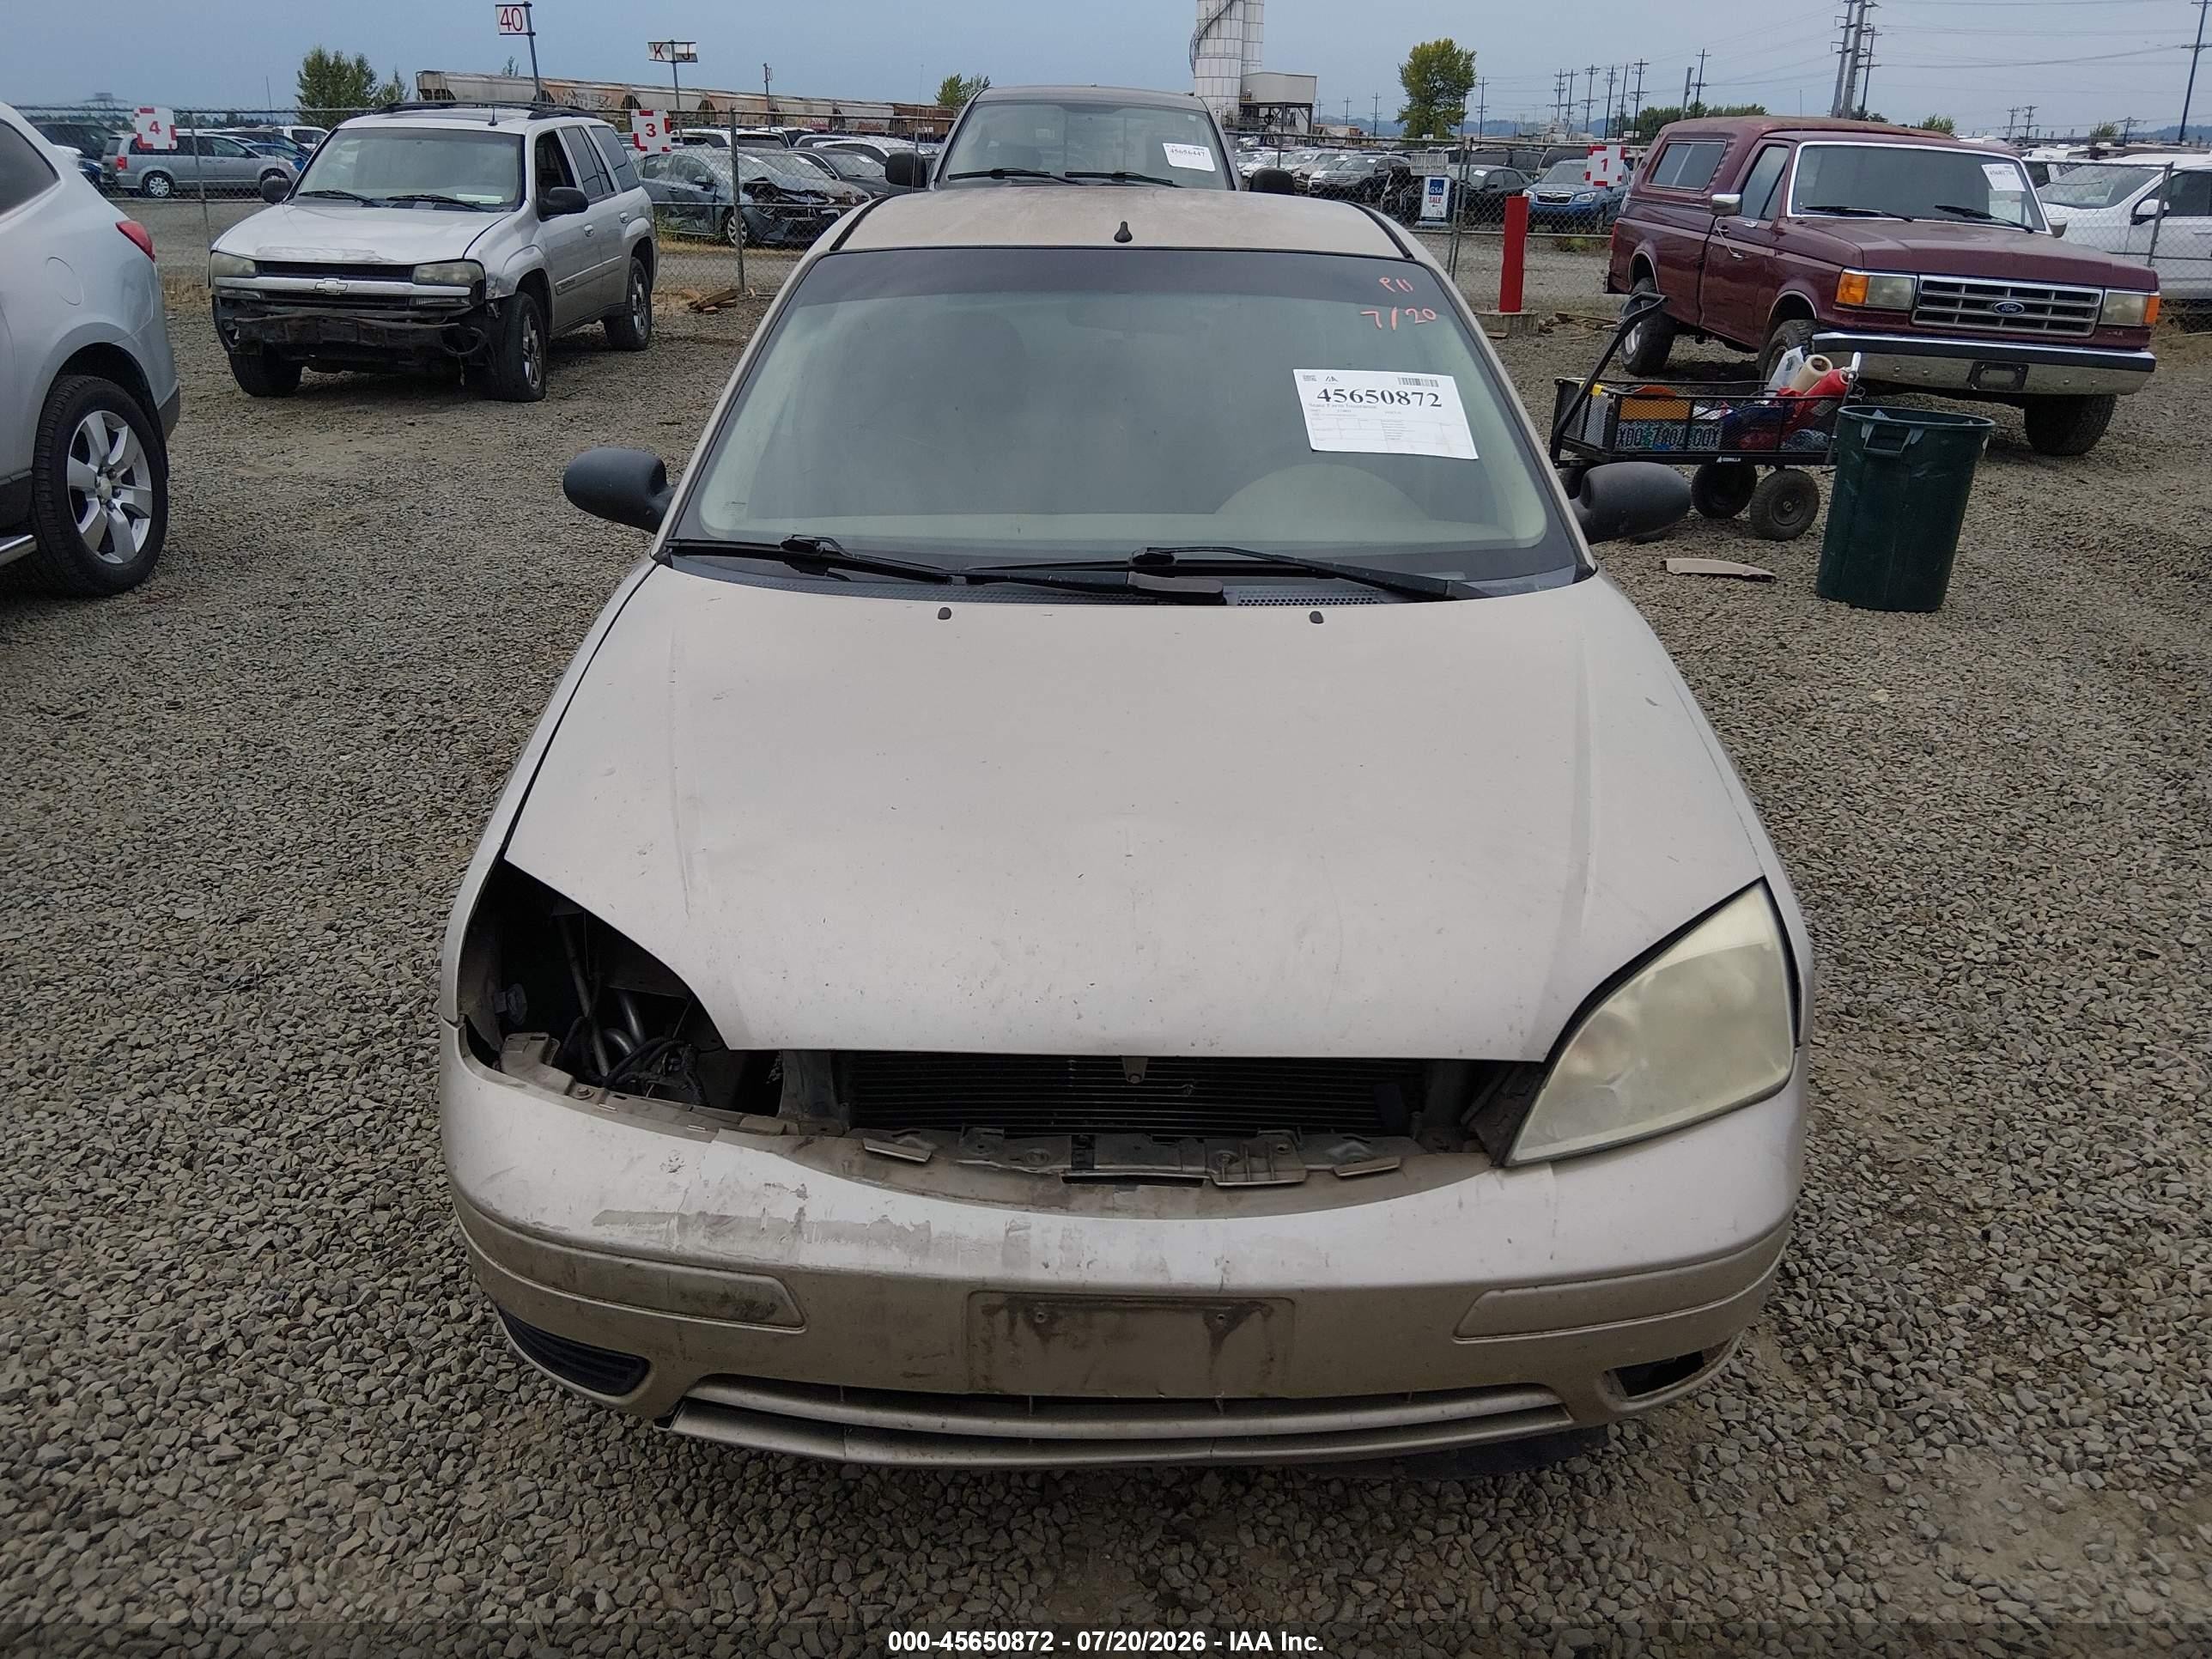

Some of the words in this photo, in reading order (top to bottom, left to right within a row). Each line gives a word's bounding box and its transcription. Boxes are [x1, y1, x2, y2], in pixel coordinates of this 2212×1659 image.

[500, 7, 523, 33] 40
[653, 44, 665, 59] K
[682, 44, 690, 60] J
[149, 120, 161, 135] 4
[645, 123, 657, 137] 3
[1600, 157, 1608, 173] 1
[1360, 306, 1437, 331] 7/20
[1316, 388, 1443, 408] 45650872
